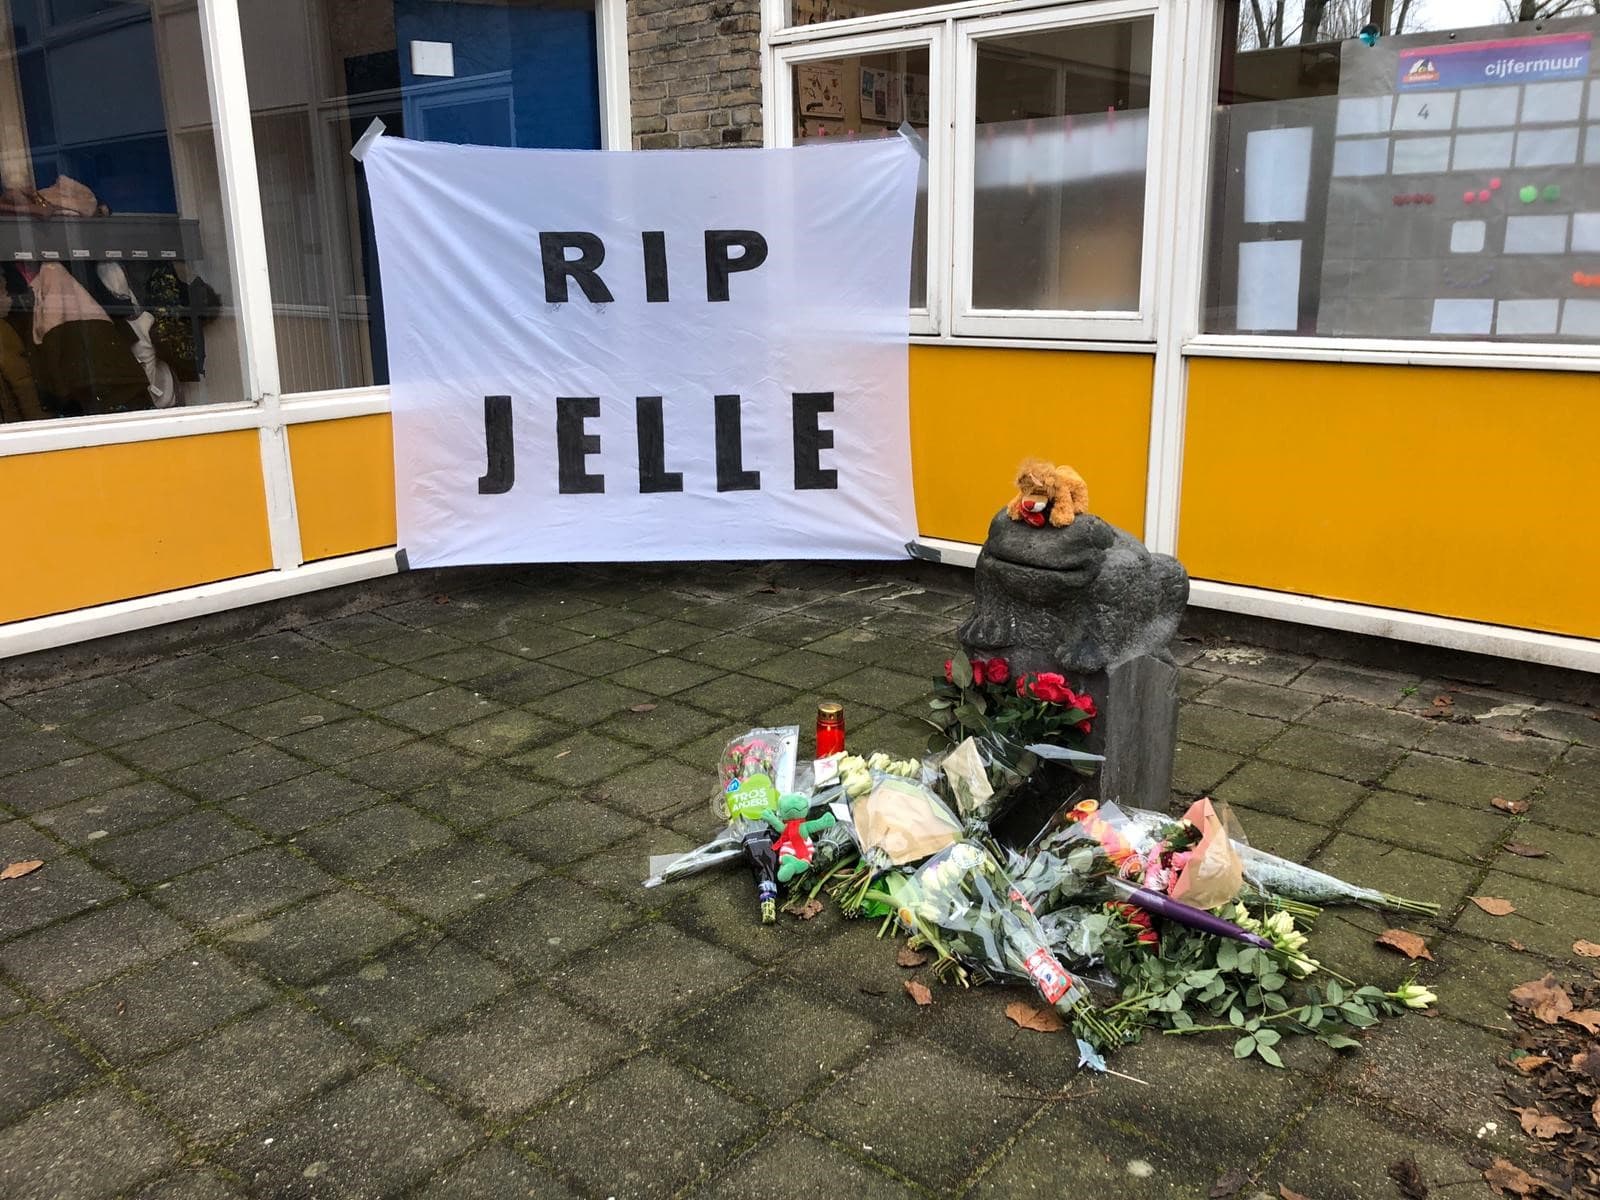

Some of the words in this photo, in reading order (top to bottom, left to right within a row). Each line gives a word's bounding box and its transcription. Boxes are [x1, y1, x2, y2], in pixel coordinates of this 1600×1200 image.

[1484, 55, 1583, 78] cijfermuur
[1417, 103, 1430, 120] 4
[539, 230, 768, 303] RIP
[479, 392, 838, 495] JELLE
[732, 788, 767, 803] TROS
